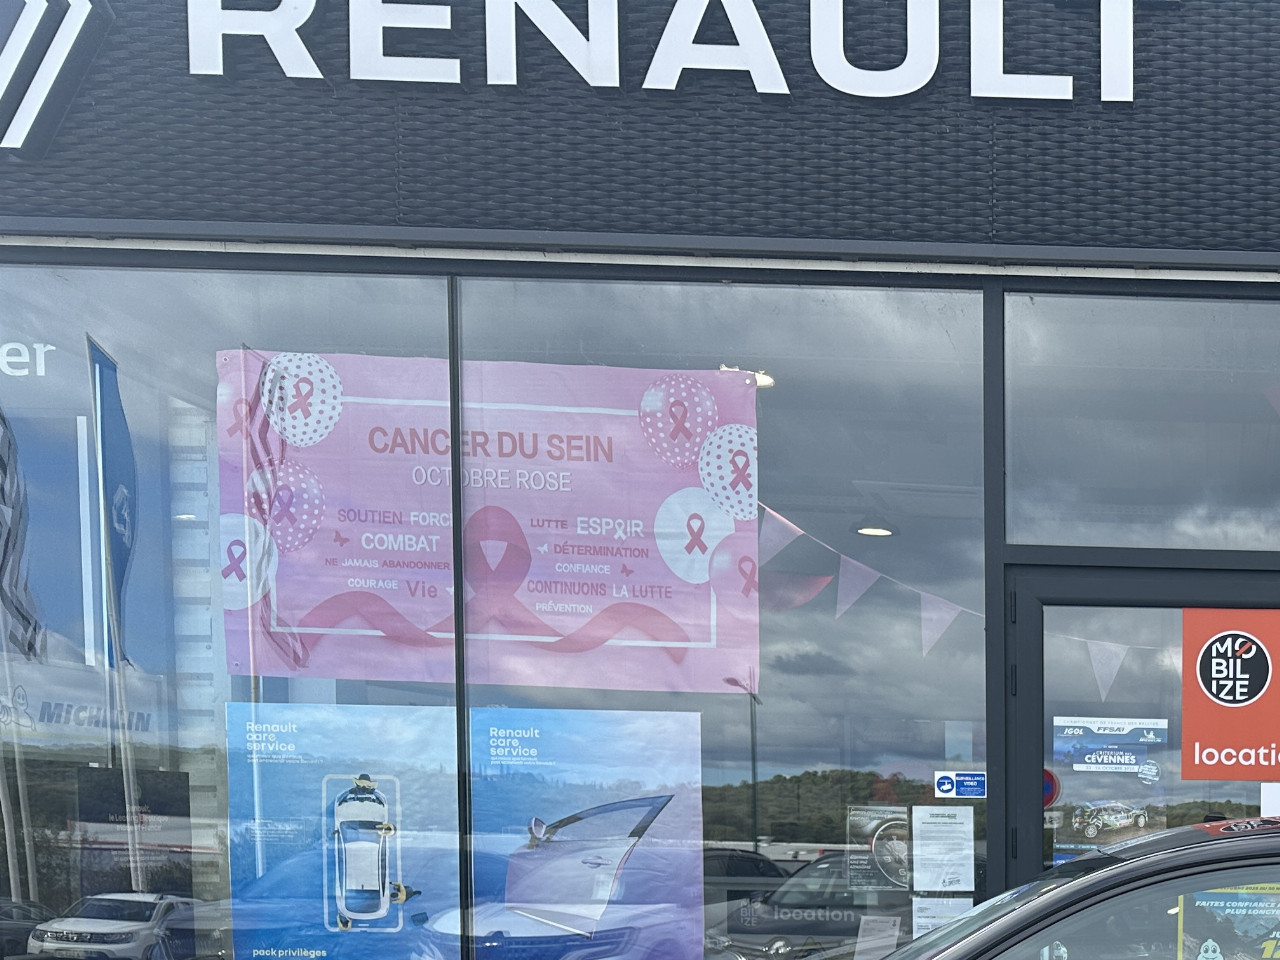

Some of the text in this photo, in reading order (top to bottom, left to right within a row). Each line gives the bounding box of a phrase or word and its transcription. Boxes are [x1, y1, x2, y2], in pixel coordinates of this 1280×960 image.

[189, 0, 1135, 102] RENAULT
[368, 426, 613, 462] CANCER DU SEIN
[412, 466, 572, 492] OCTOBRE ROSE
[338, 508, 403, 525] SOUTIEN
[530, 518, 568, 529] LUTTE
[361, 533, 440, 552] COMBAT
[554, 541, 649, 558] DÉTERMINATION
[325, 558, 450, 570] NE JAMAIS ABANDONNER
[555, 563, 611, 575] CONFIANCE
[348, 578, 438, 598] COURAGE Vie
[527, 580, 672, 599] CONTINUONS LA LUTTE
[536, 600, 593, 613] PRÉVENTION
[246, 722, 297, 732] Renault
[489, 727, 540, 738] Renault
[246, 733, 276, 741] care
[489, 738, 519, 747] care
[246, 741, 295, 751] service
[490, 746, 537, 756] service
[1085, 752, 1136, 764] CÉVENNES
[774, 906, 855, 922] location
[253, 948, 327, 958] pack privilèges
